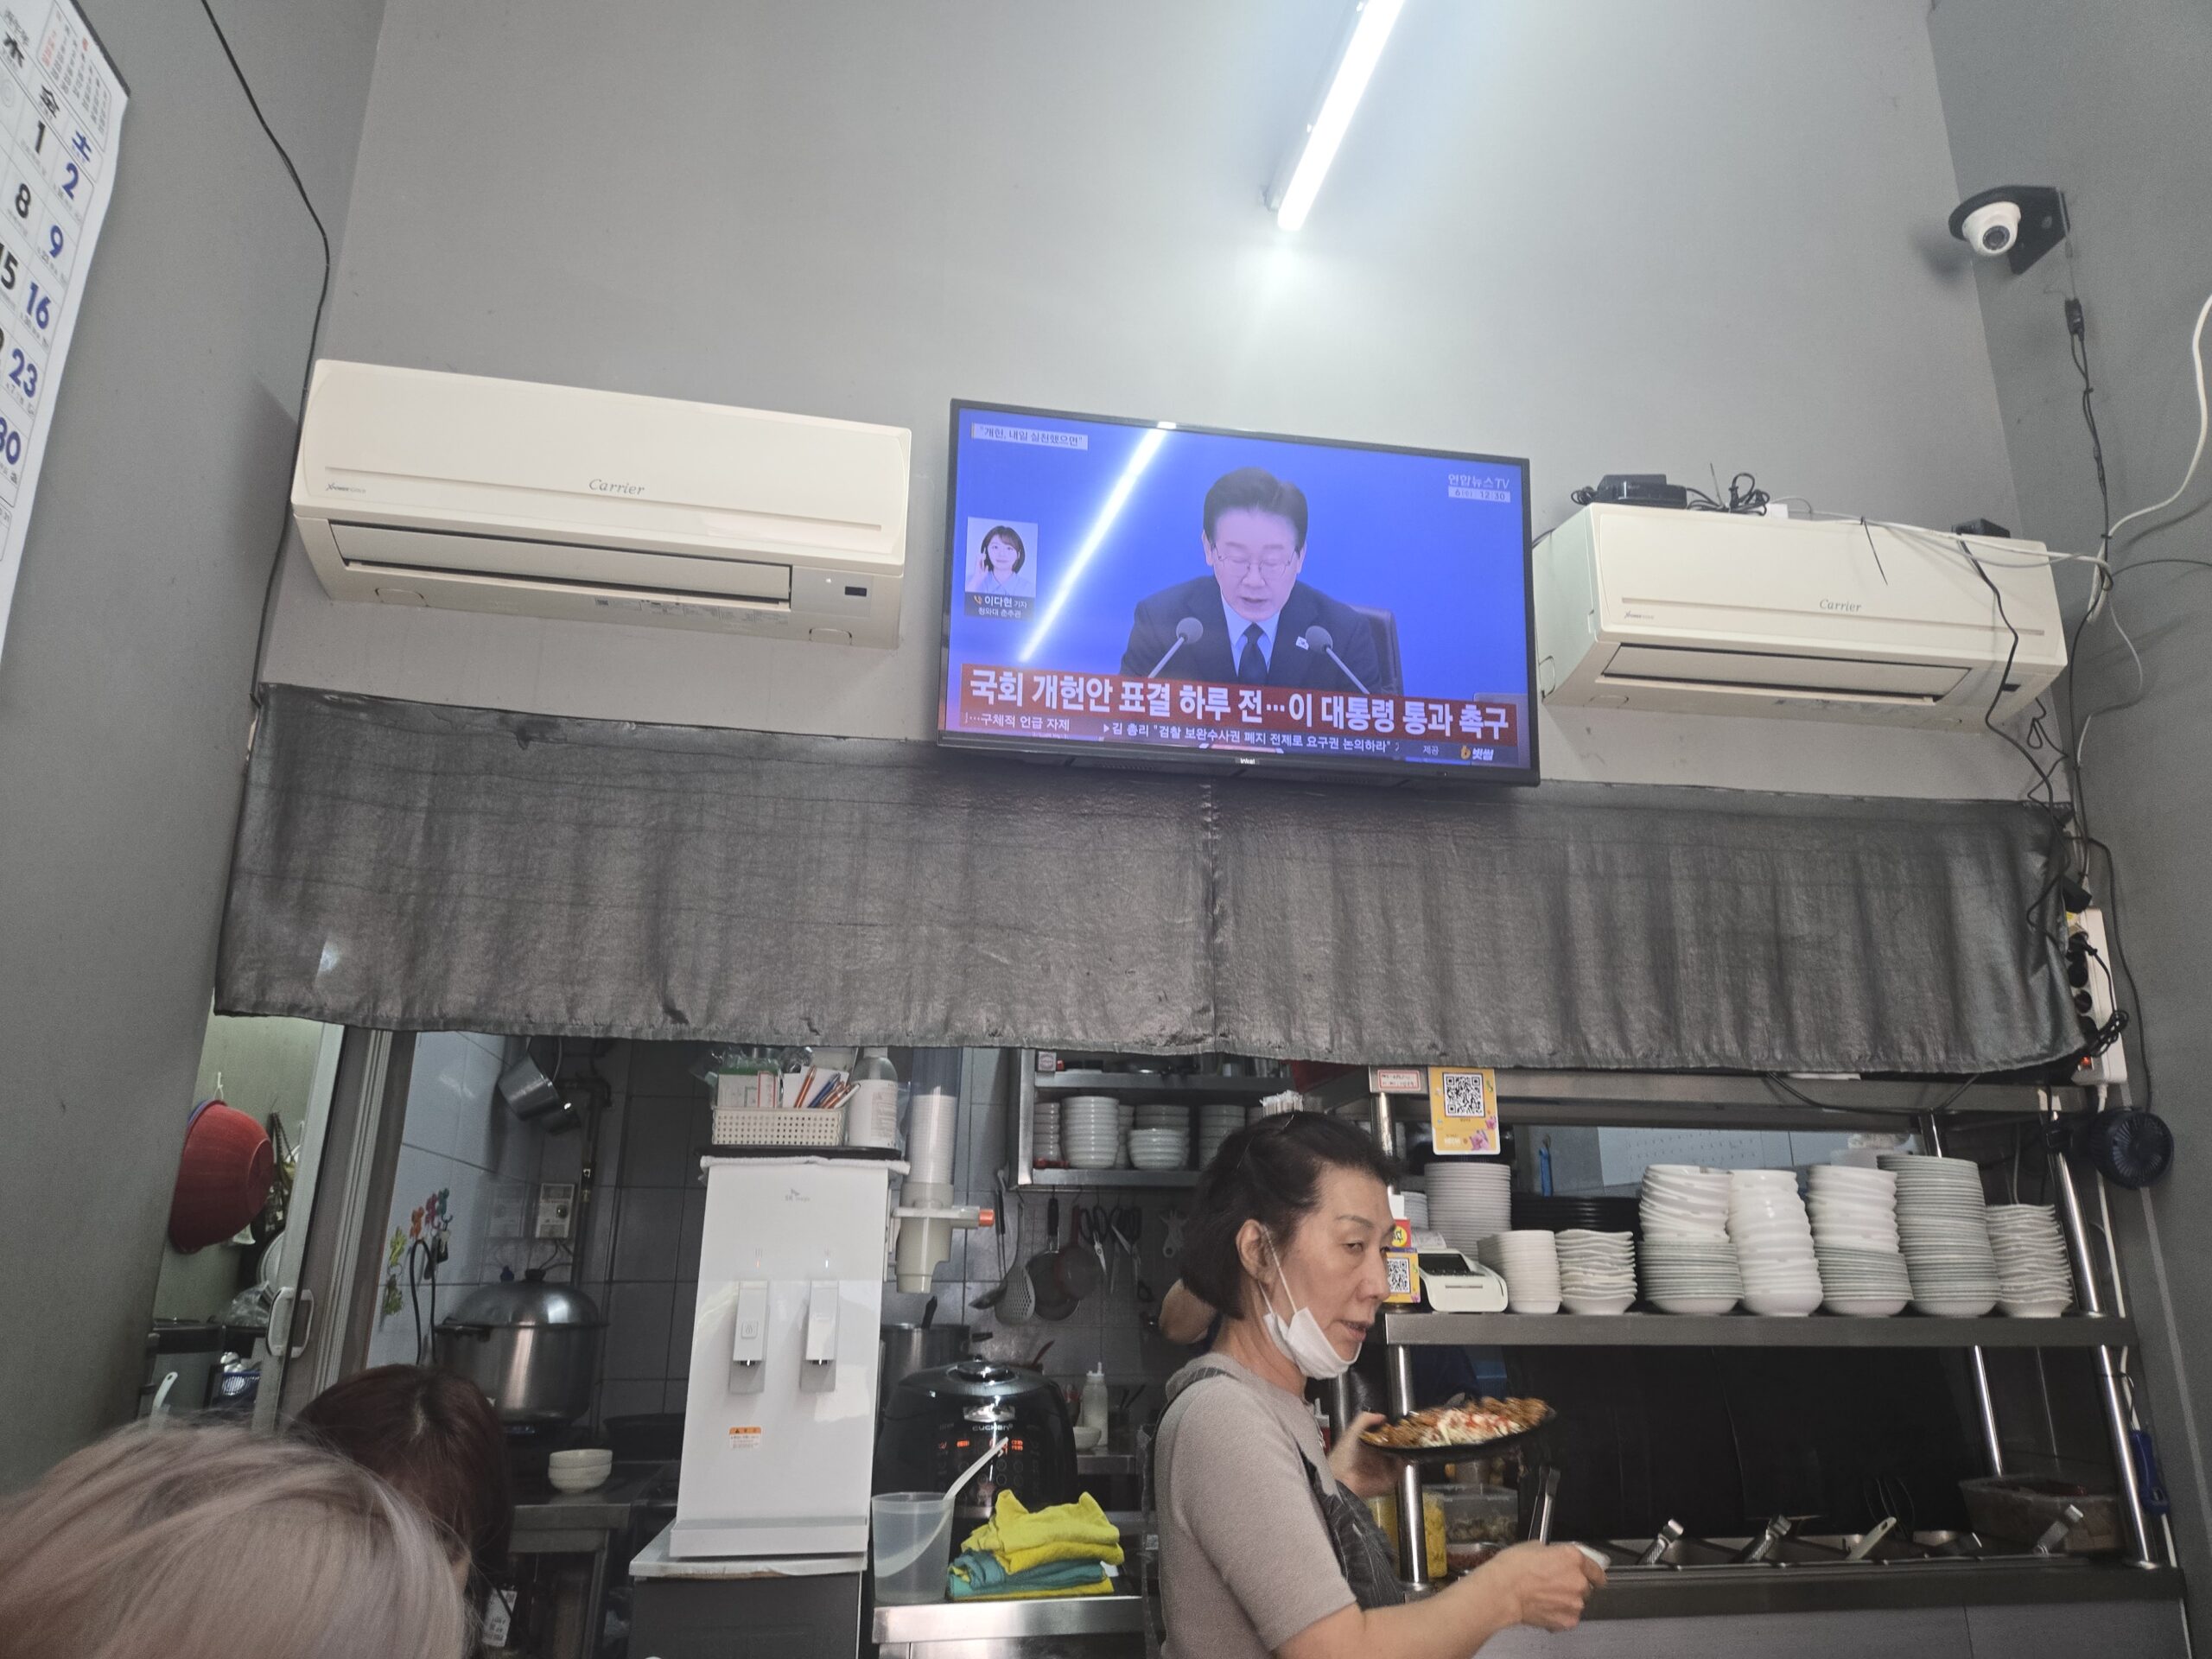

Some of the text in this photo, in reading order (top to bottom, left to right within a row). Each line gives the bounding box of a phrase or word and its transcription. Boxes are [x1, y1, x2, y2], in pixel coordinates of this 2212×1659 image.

[39, 85, 60, 118] 金
[71, 130, 92, 162] 土
[35, 119, 46, 155] 1
[61, 162, 79, 200] 2
[15, 182, 31, 219] 8
[48, 224, 64, 258] 9
[27, 281, 52, 329] 16
[9, 347, 38, 398] 23
[1008, 429, 1028, 442] 내일
[588, 478, 645, 495] Carrier
[1448, 474, 1510, 489] 연합뉴스TV
[984, 595, 1013, 607] 이다현
[1820, 598, 1862, 613] Carrier
[969, 669, 1023, 707] 국회
[1032, 674, 1113, 713] 개헌안
[1119, 681, 1170, 718] 표결
[1179, 684, 1231, 721] 하루
[1321, 695, 1395, 733] 대통령
[1402, 700, 1453, 737] 통과
[1459, 703, 1509, 740] 촉구
[1020, 715, 1043, 729] 언급
[1046, 718, 1070, 731] 자제
[1112, 721, 1122, 735] 김
[1127, 722, 1149, 737] 총리
[1185, 726, 1241, 743] 보완수사권
[1243, 731, 1267, 745] 폐지
[1269, 733, 1303, 747] 전제로
[1306, 736, 1338, 750] 요구권
[1423, 745, 1440, 756] 제공
